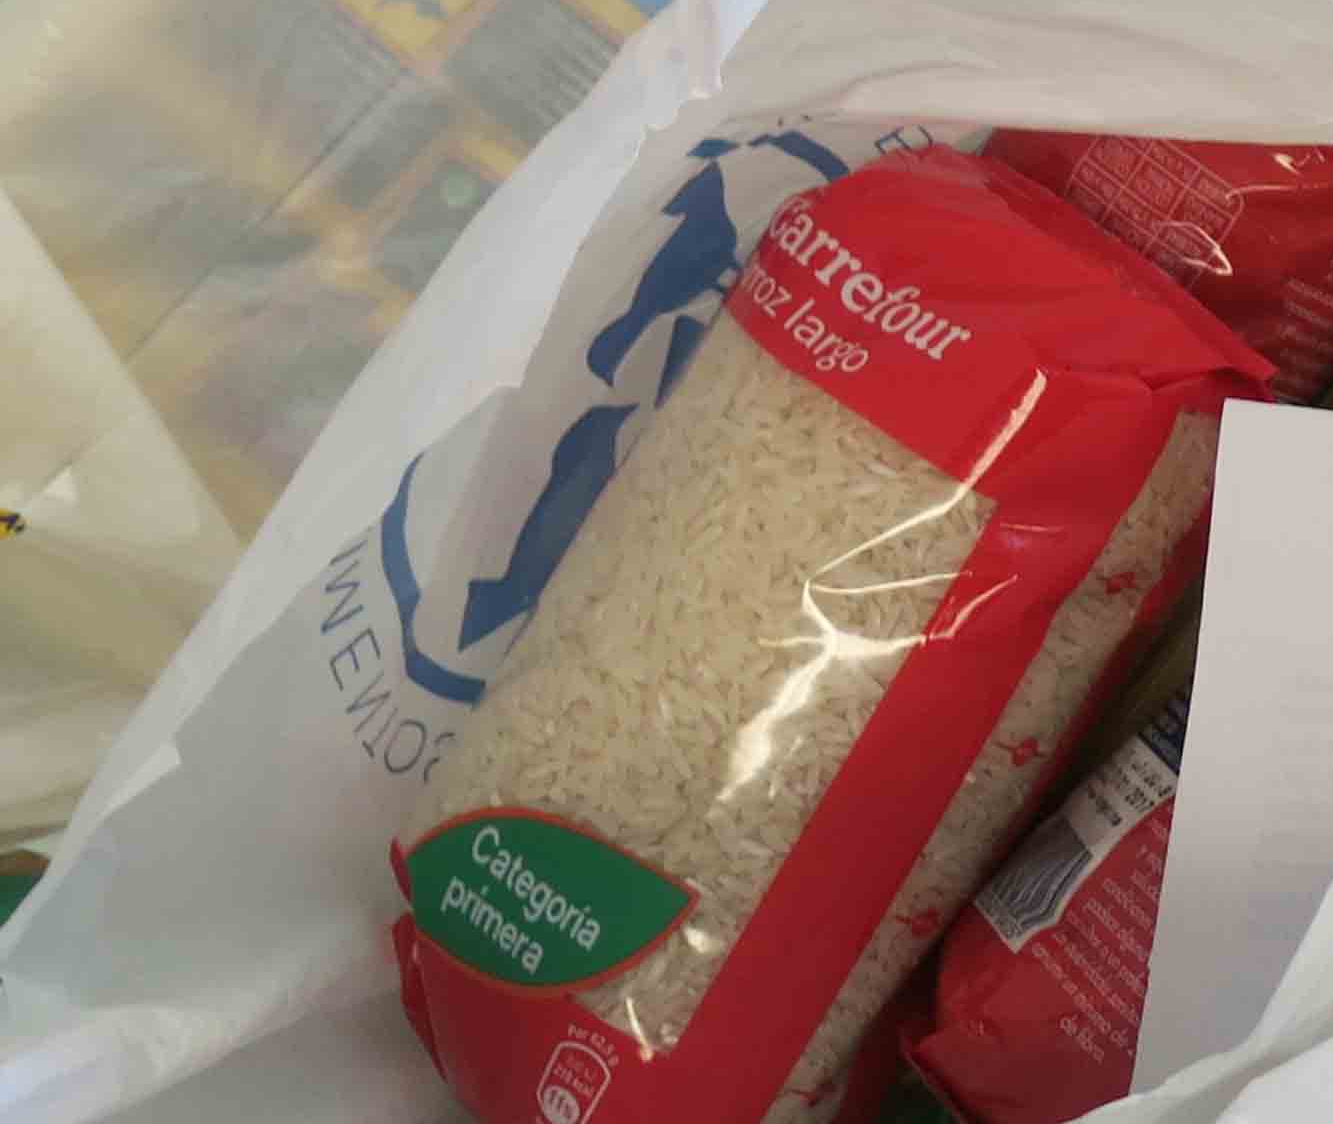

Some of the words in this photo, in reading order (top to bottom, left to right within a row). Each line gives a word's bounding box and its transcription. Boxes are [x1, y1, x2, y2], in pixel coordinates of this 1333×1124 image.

[767, 195, 972, 362] Carrefour
[787, 299, 871, 371] largo
[444, 876, 544, 975] primera
